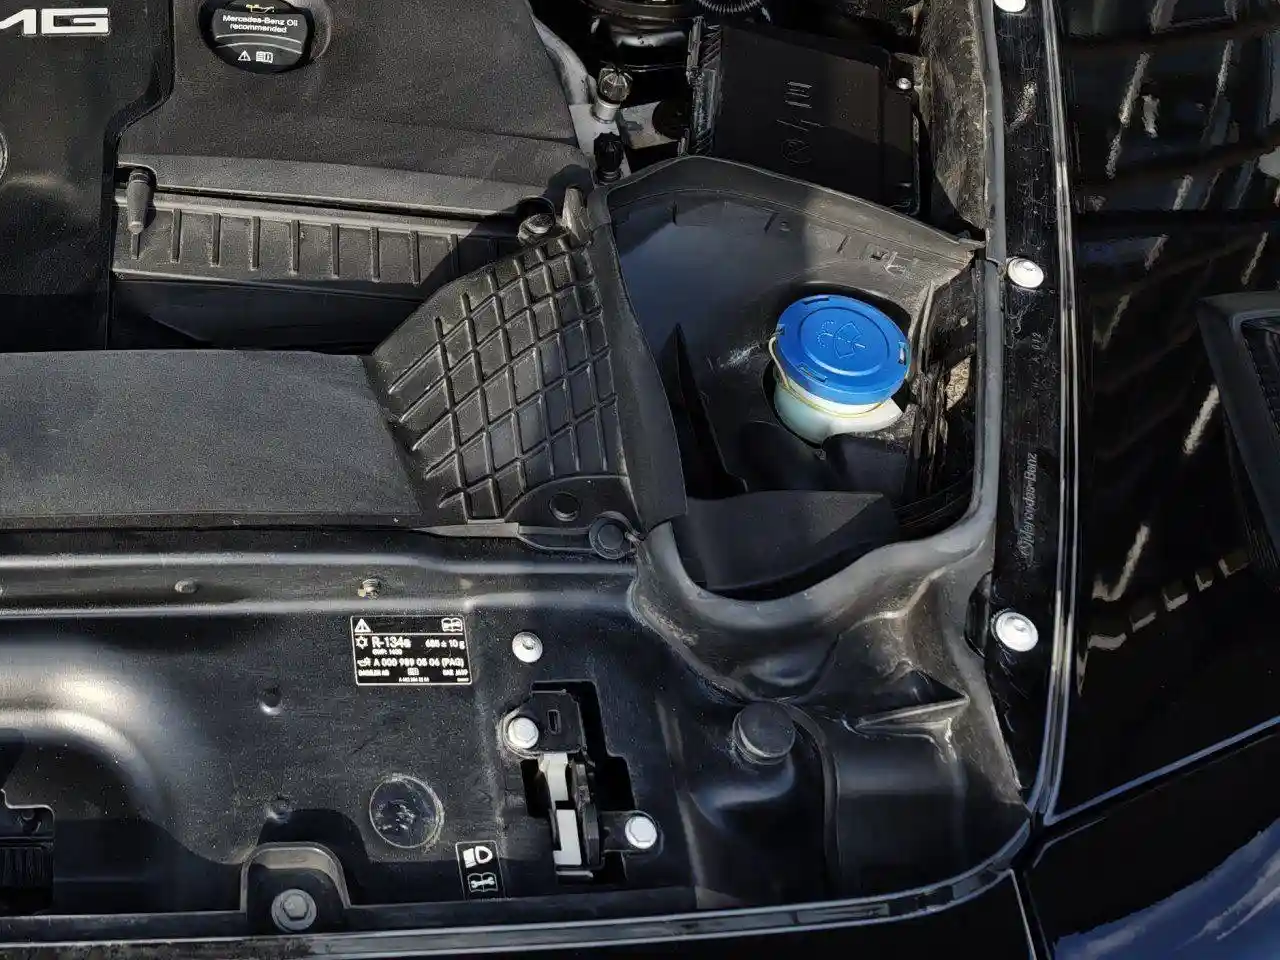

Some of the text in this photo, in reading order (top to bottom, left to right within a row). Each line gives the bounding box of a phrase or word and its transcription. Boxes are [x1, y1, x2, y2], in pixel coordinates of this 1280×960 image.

[222, 14, 298, 27] Mercedes-Benz Oil
[229, 23, 288, 33] recommended
[371, 636, 412, 648] R-134a
[373, 658, 380, 667] A
[441, 658, 464, 668] (PAG)
